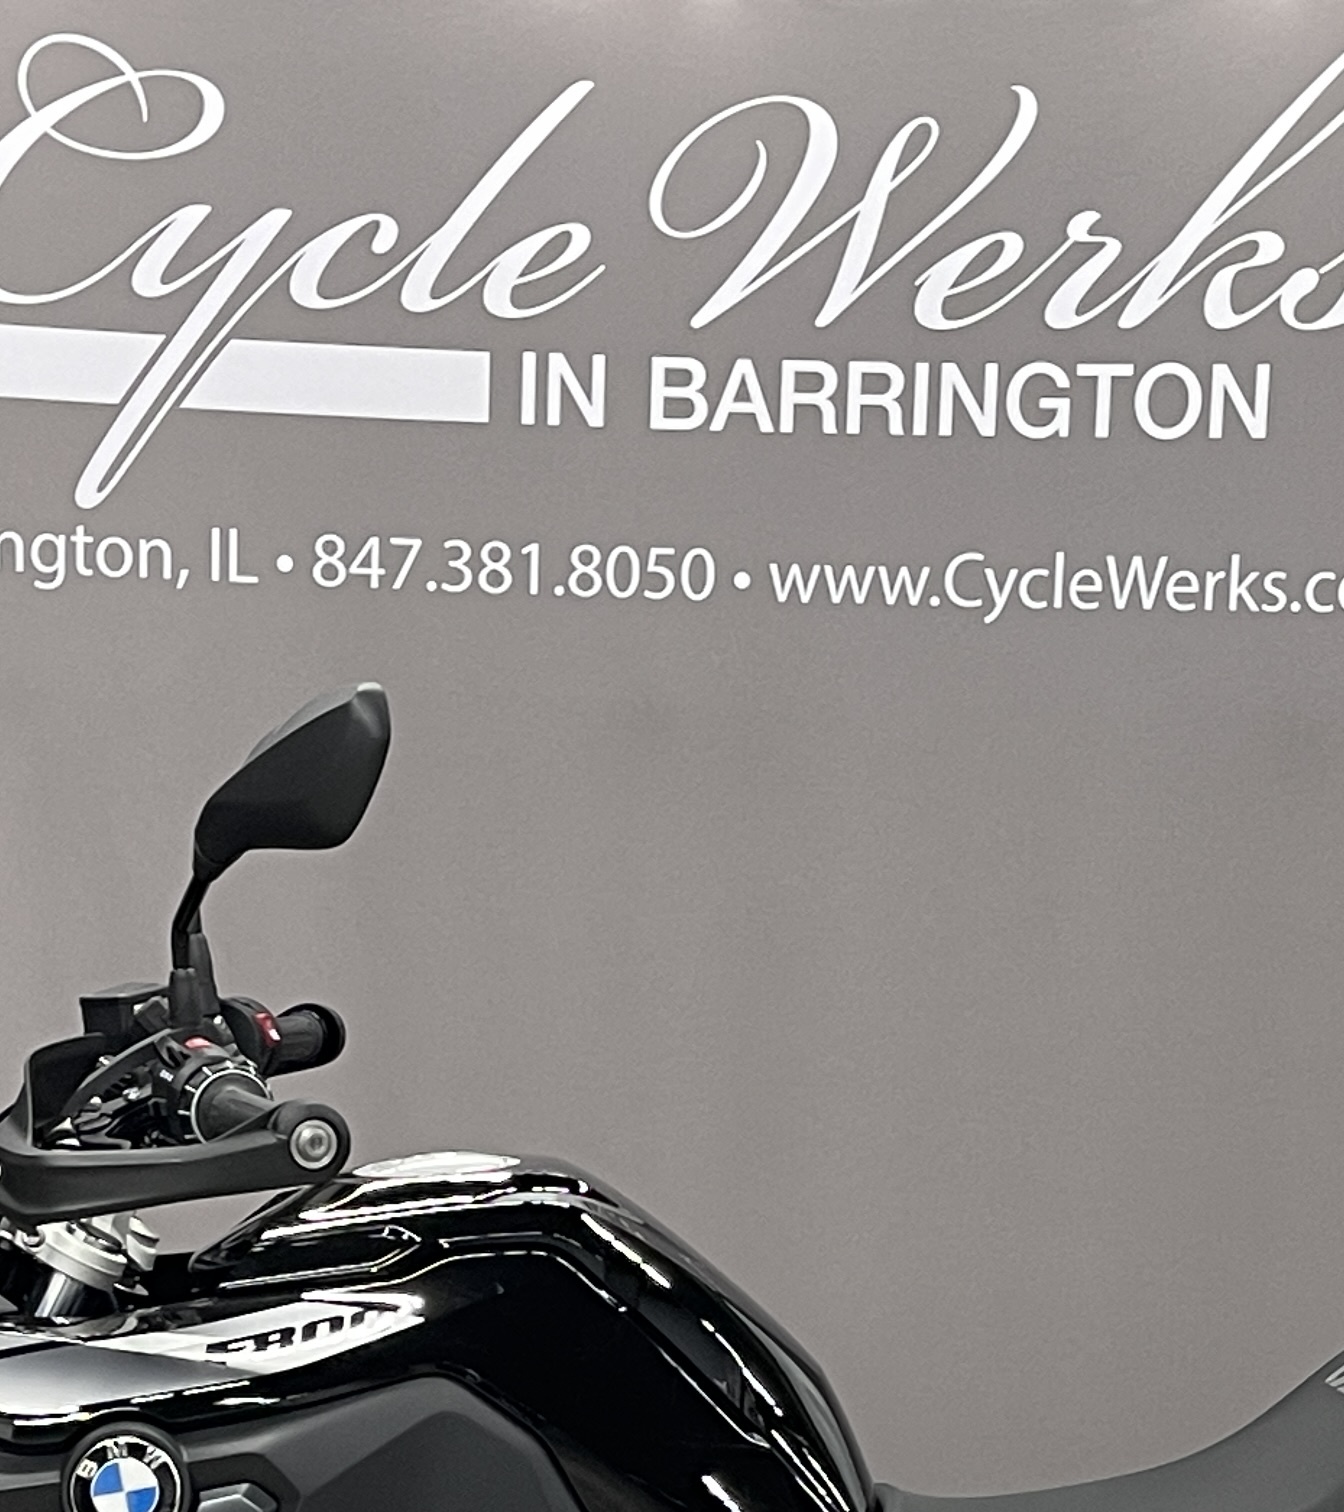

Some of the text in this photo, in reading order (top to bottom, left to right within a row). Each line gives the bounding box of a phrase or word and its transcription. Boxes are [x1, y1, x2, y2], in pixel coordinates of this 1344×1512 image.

[520, 350, 1272, 440] IN BARRINGTON
[211, 526, 260, 584] IL
[312, 533, 715, 602] 847.381.8050
[76, 1440, 164, 1480] BMW
